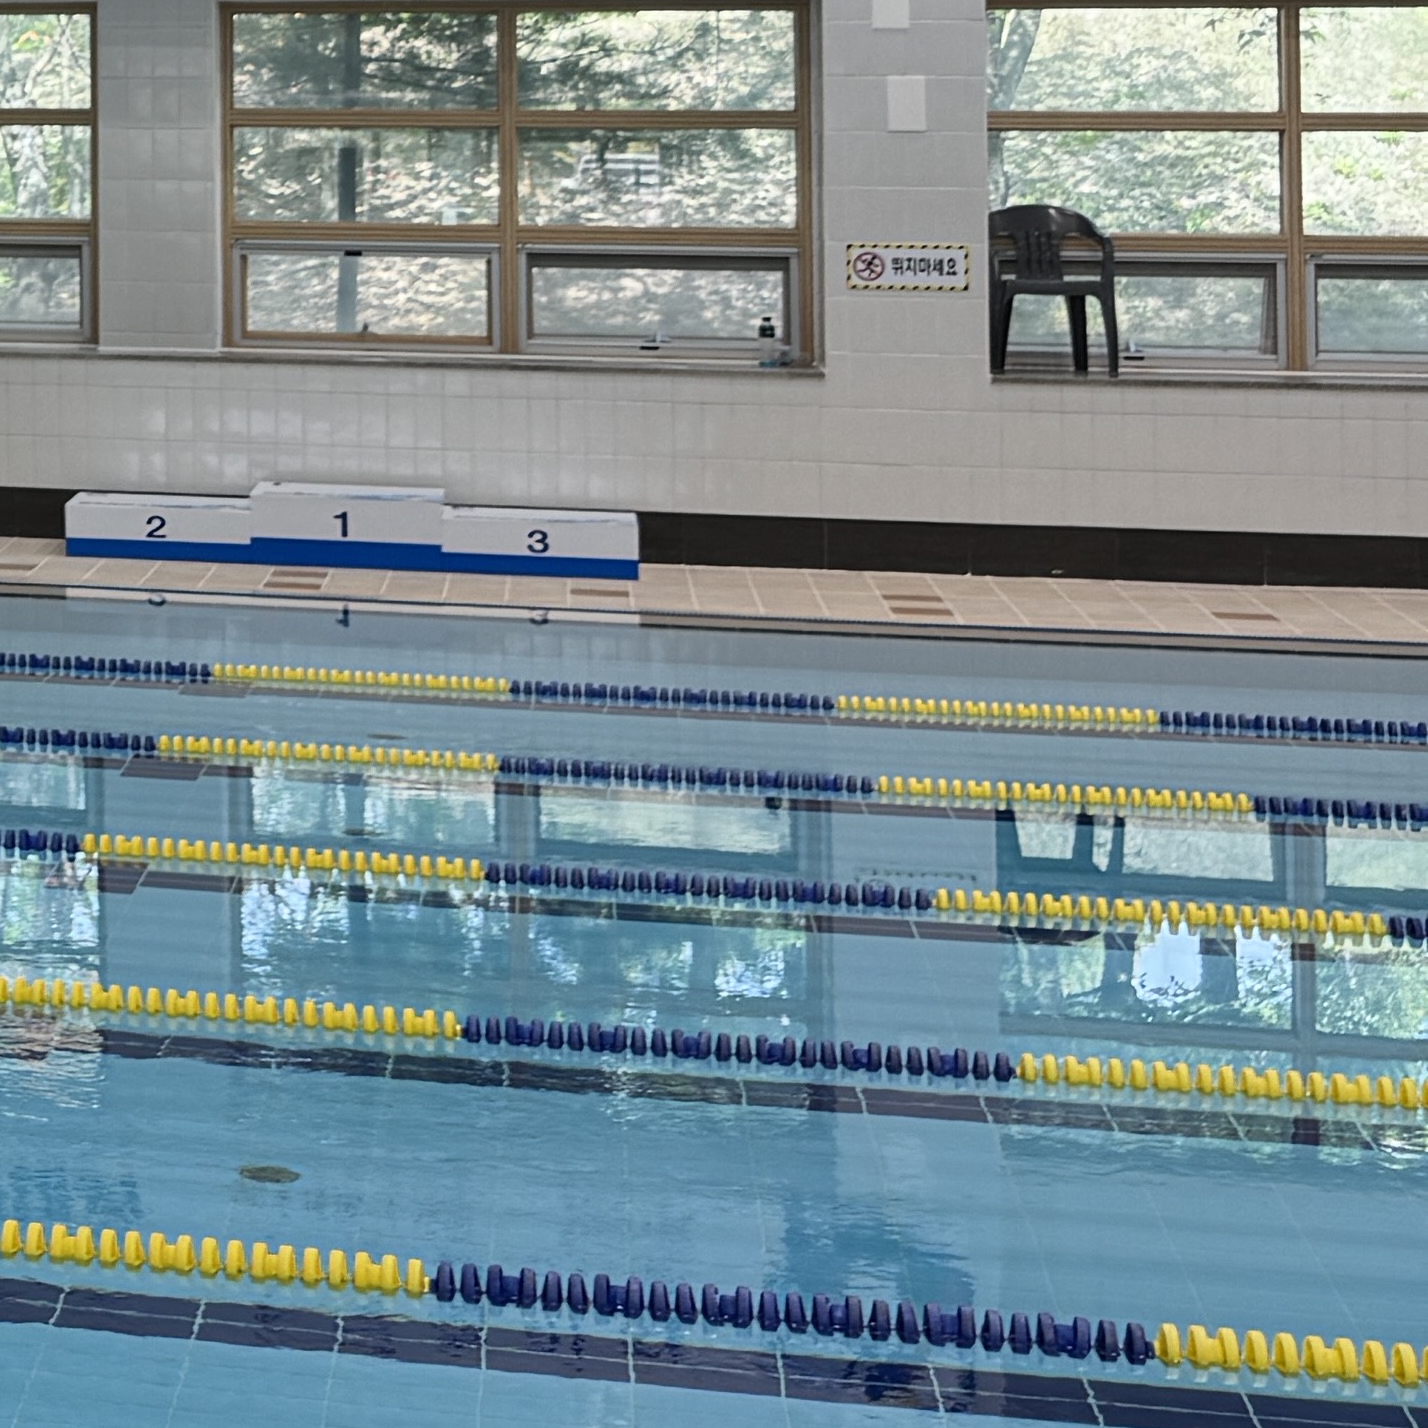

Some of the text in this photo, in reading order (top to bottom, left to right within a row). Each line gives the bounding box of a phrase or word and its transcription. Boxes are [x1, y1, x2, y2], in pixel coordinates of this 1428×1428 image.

[145, 515, 168, 539] 2
[333, 511, 349, 538] 1
[526, 529, 550, 554] 3
